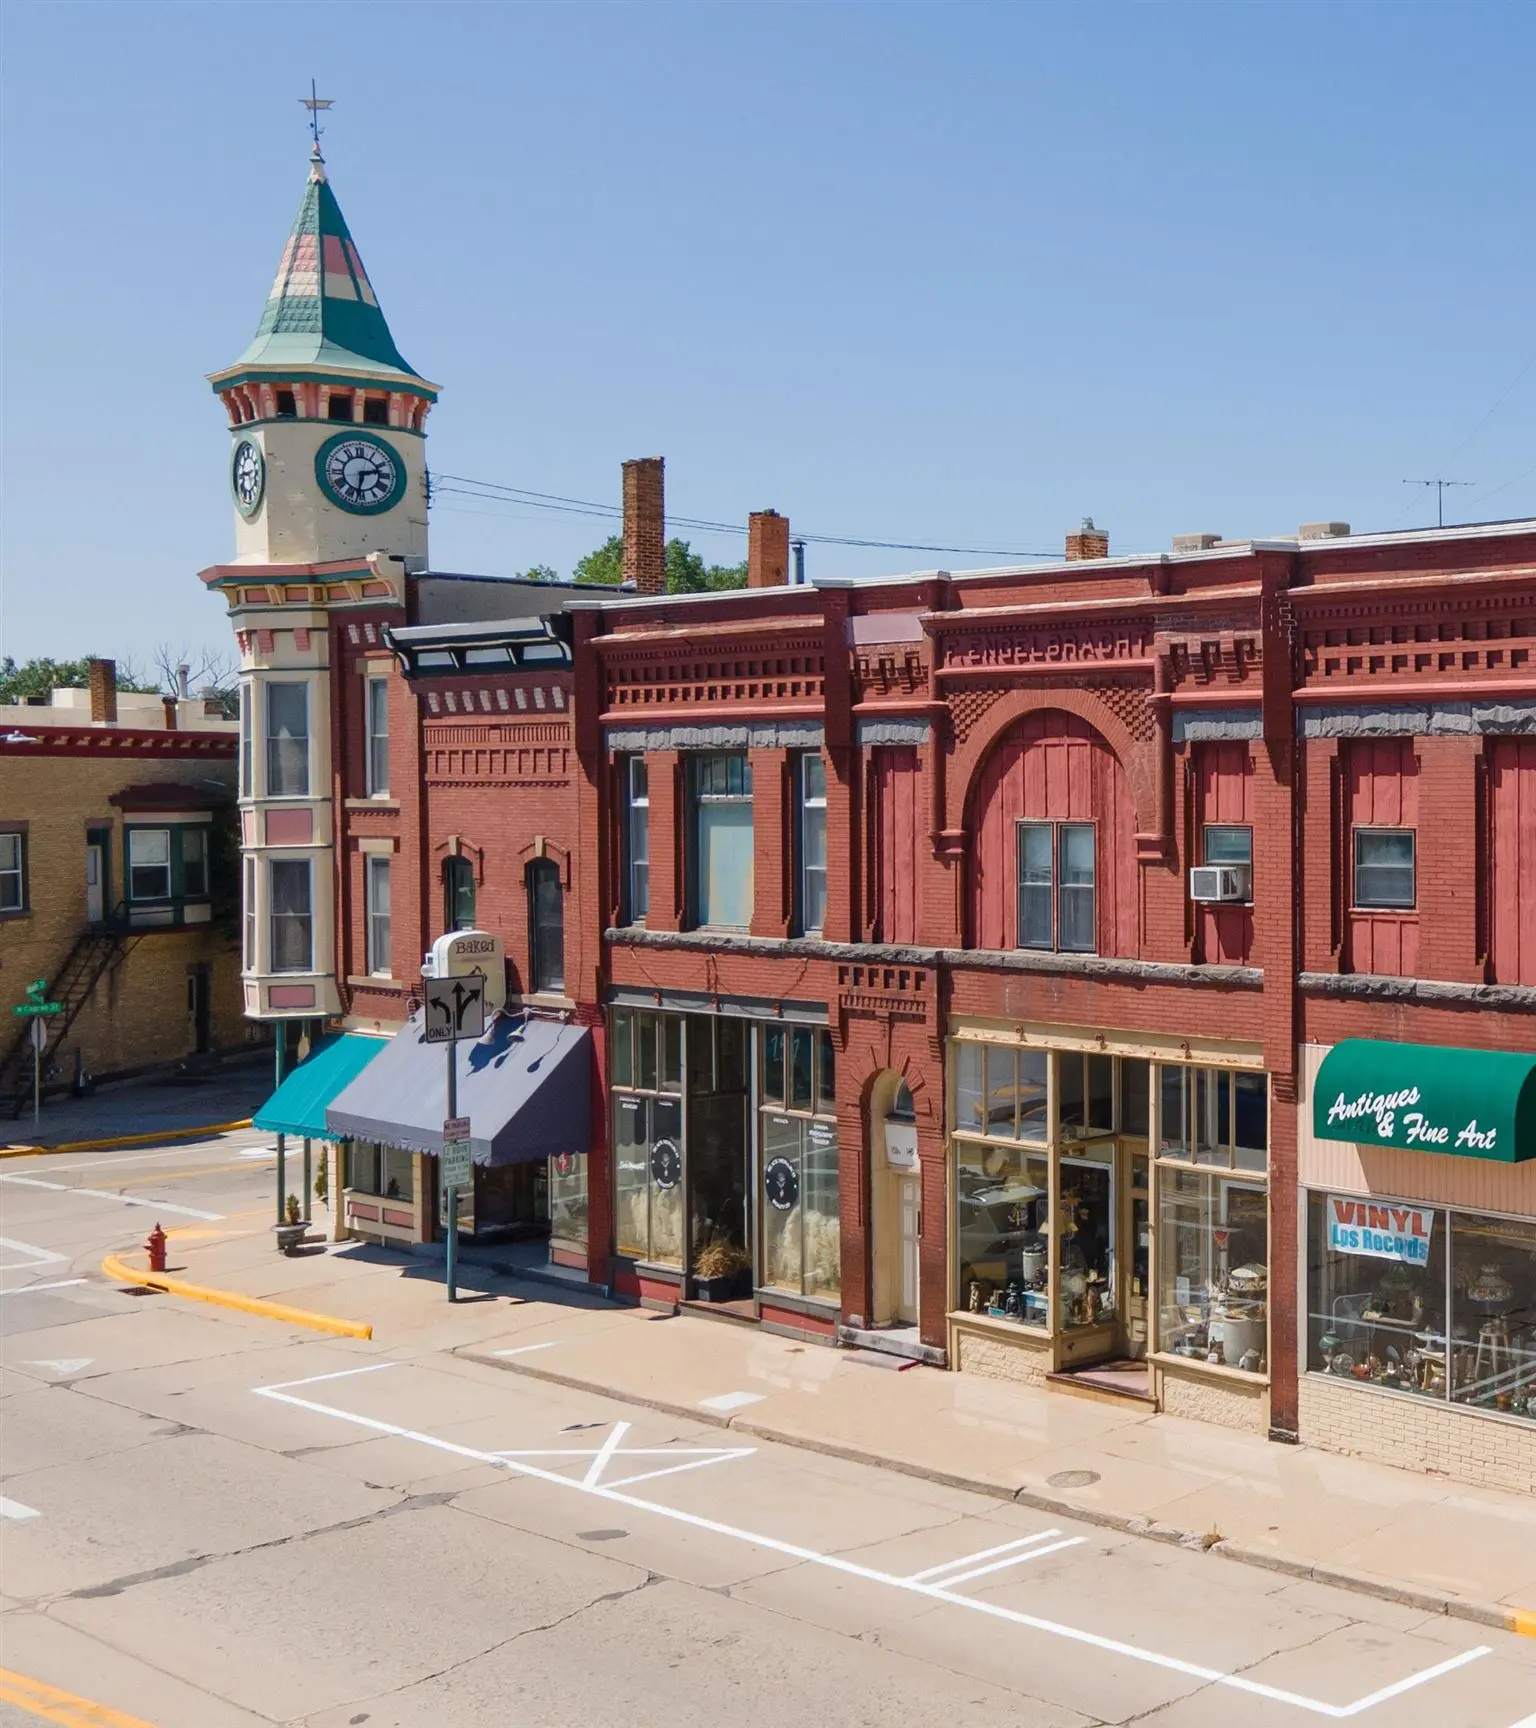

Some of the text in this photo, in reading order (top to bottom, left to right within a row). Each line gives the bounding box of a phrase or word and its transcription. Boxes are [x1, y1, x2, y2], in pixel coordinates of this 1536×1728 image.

[455, 939, 495, 954] Baked
[429, 1026, 453, 1039] ONLY
[1327, 1086, 1421, 1125] Antiques
[1378, 1112, 1497, 1150] & Fine Art
[1333, 1200, 1428, 1237] VINYL
